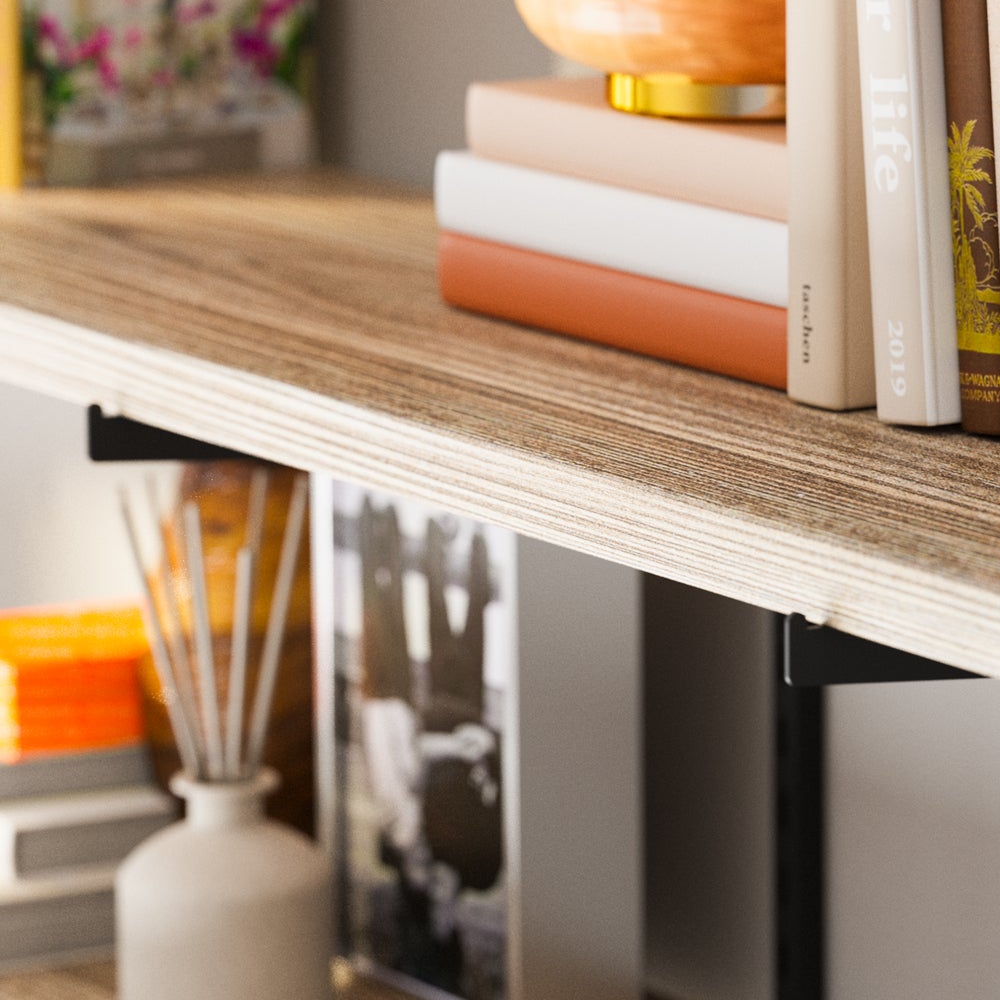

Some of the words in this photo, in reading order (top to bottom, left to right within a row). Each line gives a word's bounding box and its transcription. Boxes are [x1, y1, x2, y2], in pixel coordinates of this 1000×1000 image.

[868, 73, 912, 193] life
[801, 283, 813, 365] taschen
[886, 319, 908, 398] 2019
